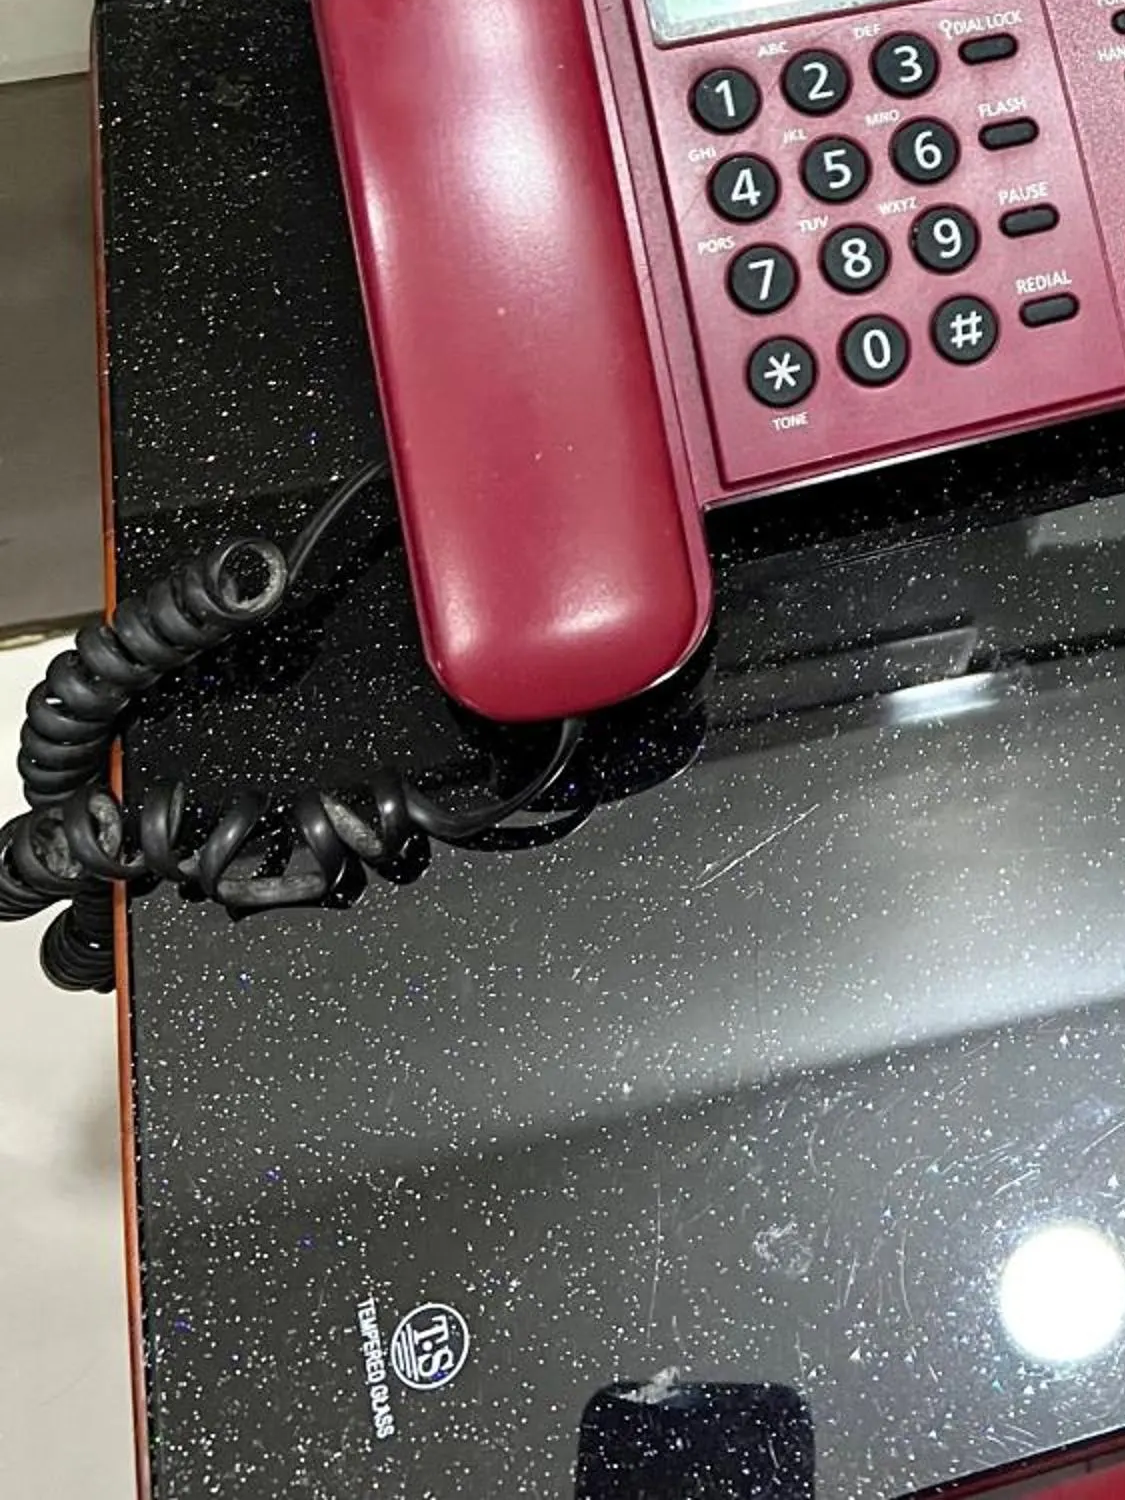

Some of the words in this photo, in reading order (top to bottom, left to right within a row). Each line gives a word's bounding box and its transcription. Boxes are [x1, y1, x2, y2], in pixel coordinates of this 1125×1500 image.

[853, 23, 881, 39] DEF
[953, 18, 984, 35] DIAL
[987, 9, 1022, 28] LOCK
[757, 40, 789, 58] ABC
[893, 45, 923, 83] 3
[714, 79, 736, 117] 1
[803, 62, 835, 102] 2
[978, 97, 1027, 118] FLASH
[688, 147, 717, 162] GHI
[914, 130, 942, 169] 6
[731, 168, 761, 207] 4
[823, 149, 852, 189] 5
[879, 196, 917, 215] WXYZ
[998, 183, 1049, 204] PAUSE
[800, 215, 829, 232] TUV
[932, 217, 962, 258] 9
[842, 238, 872, 278] 8
[749, 259, 775, 300] 7
[1016, 269, 1073, 294] REDIAL
[863, 329, 891, 369] 0
[773, 412, 809, 431] TONE
[357, 1298, 387, 1383] TEMPERED
[370, 1384, 395, 1439] GLASS
